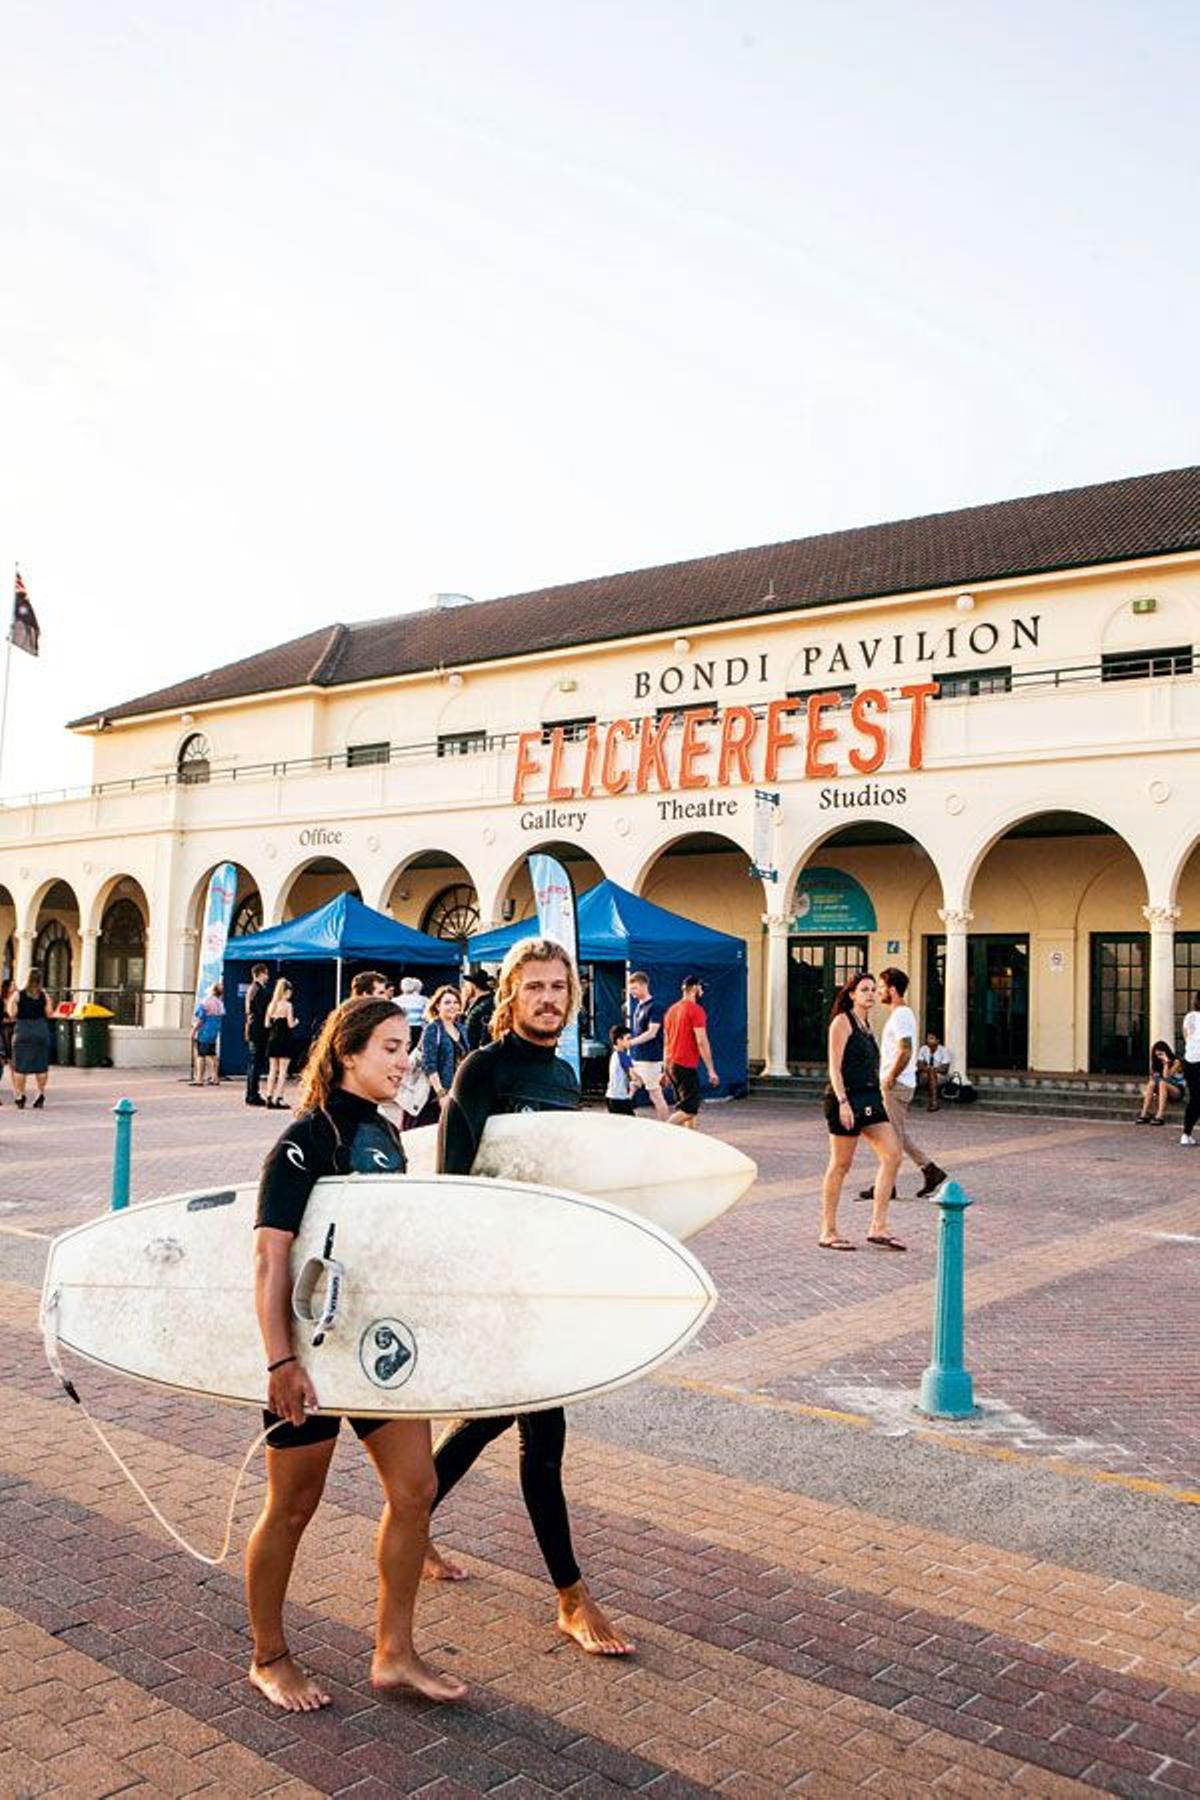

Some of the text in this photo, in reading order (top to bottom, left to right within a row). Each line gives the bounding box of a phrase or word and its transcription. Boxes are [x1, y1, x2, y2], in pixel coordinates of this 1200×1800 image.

[634, 614, 1042, 699] BONDI PAVILION
[512, 682, 940, 805] FLICKERFEST
[657, 796, 739, 822] Theatre
[818, 785, 908, 811] Studios
[520, 809, 587, 832] Gallery
[299, 828, 342, 846] Office
